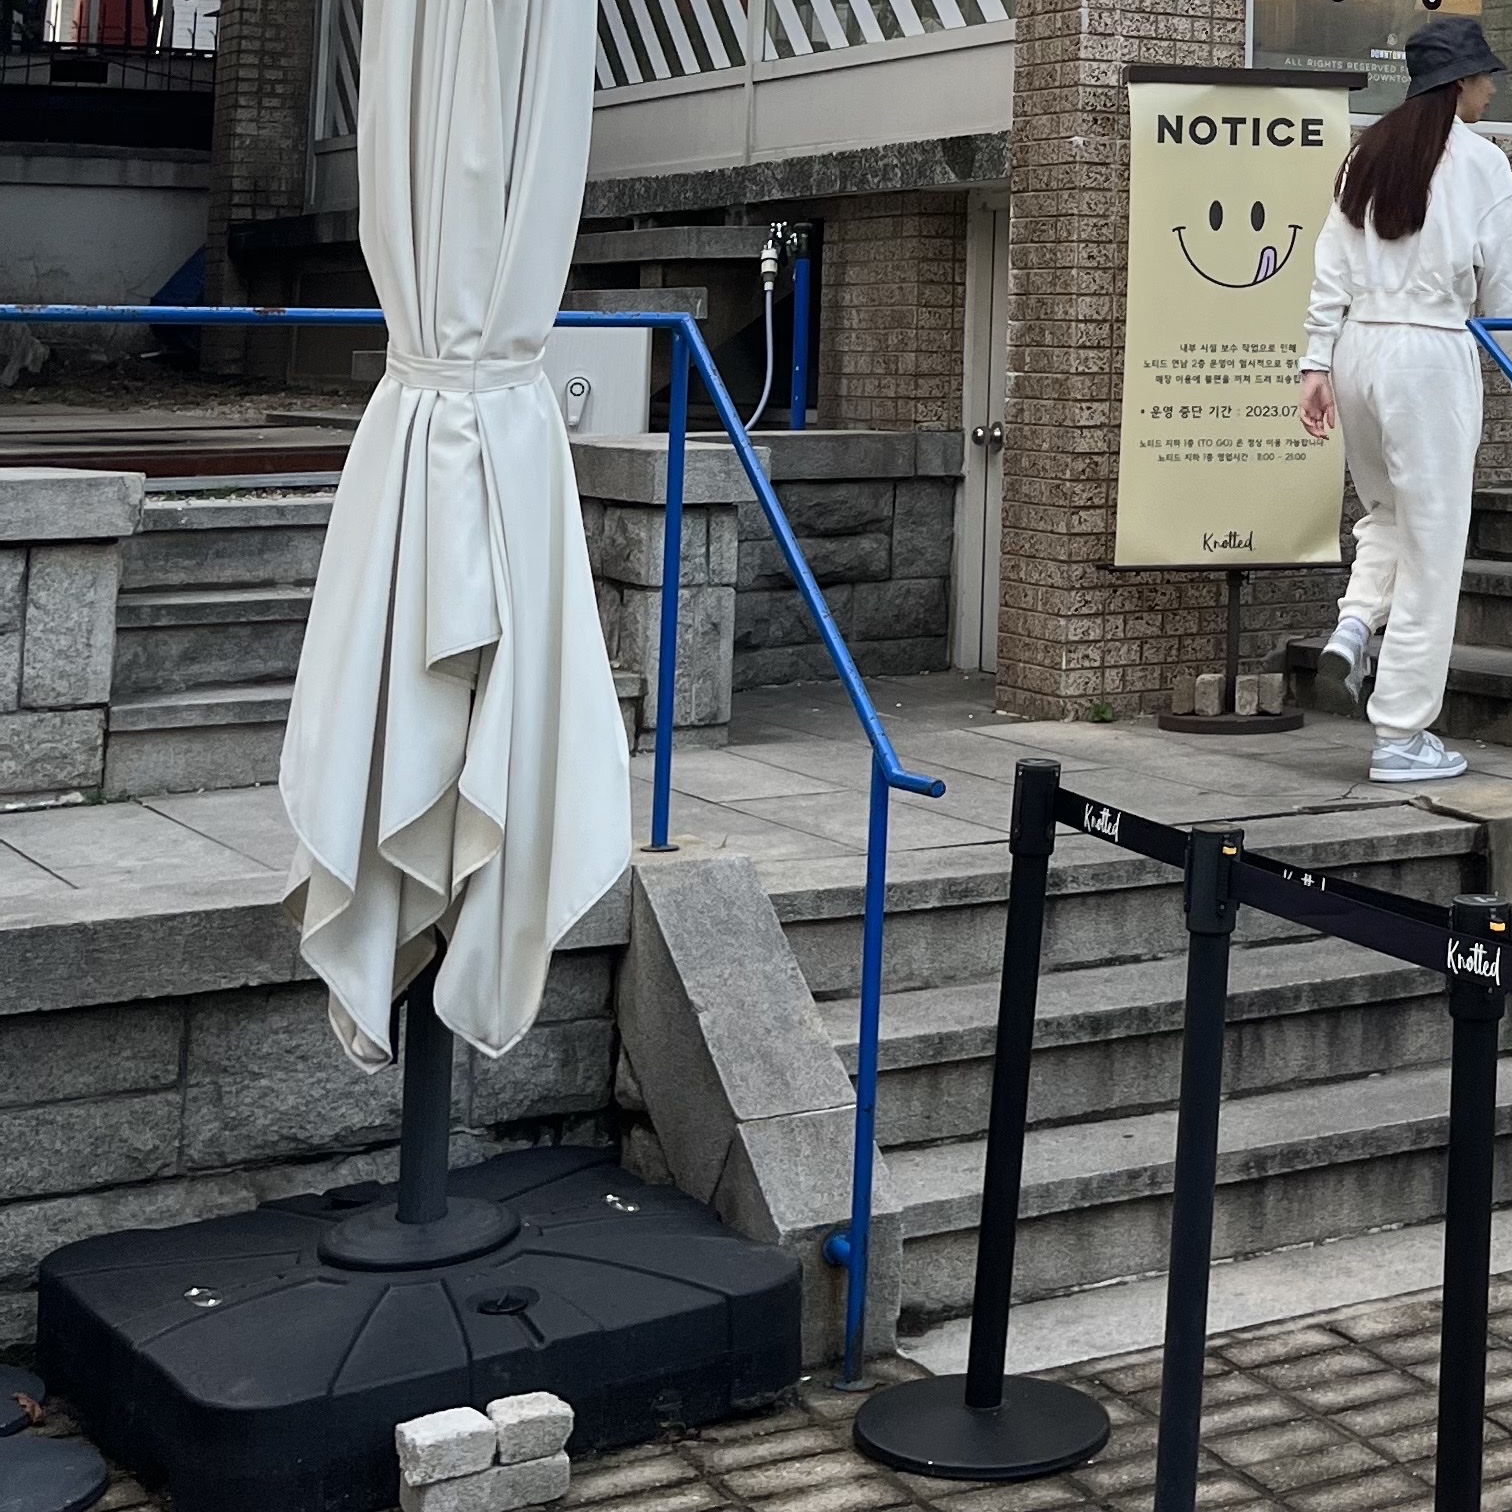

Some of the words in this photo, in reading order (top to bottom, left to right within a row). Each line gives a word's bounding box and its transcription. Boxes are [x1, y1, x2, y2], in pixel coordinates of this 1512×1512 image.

[1284, 57, 1303, 67] ALL
[1307, 58, 1343, 70] RIGHTS
[1346, 61, 1397, 74] RESERVED
[1157, 114, 1324, 147] NOTICE
[1180, 344, 1196, 353] 내부
[1200, 344, 1217, 353] 시설
[1221, 344, 1239, 353] 보수
[1242, 344, 1276, 353] 작업으로
[1280, 344, 1297, 353] 인해
[1143, 359, 1167, 369] 노티드
[1172, 359, 1188, 369] 연남
[1192, 359, 1206, 369] 2층
[1210, 359, 1235, 369] 운영이
[1155, 374, 1172, 384] 매장
[1176, 374, 1200, 384] 이용에
[1205, 374, 1229, 384] 불편을
[1255, 374, 1272, 384] 드려
[1150, 404, 1173, 419] 운영
[1179, 404, 1202, 419] 중단
[1208, 404, 1232, 419] 기간
[1139, 438, 1162, 448] 노티드
[1166, 438, 1180, 448] 지하
[1266, 438, 1280, 448] 이용
[1158, 452, 1181, 462] 노티드
[1185, 452, 1200, 462] 지하
[1217, 452, 1248, 462] 영업시간
[1203, 530, 1253, 553] Knotted
[1083, 802, 1122, 843] Knotted
[1447, 937, 1501, 986] Knotted
